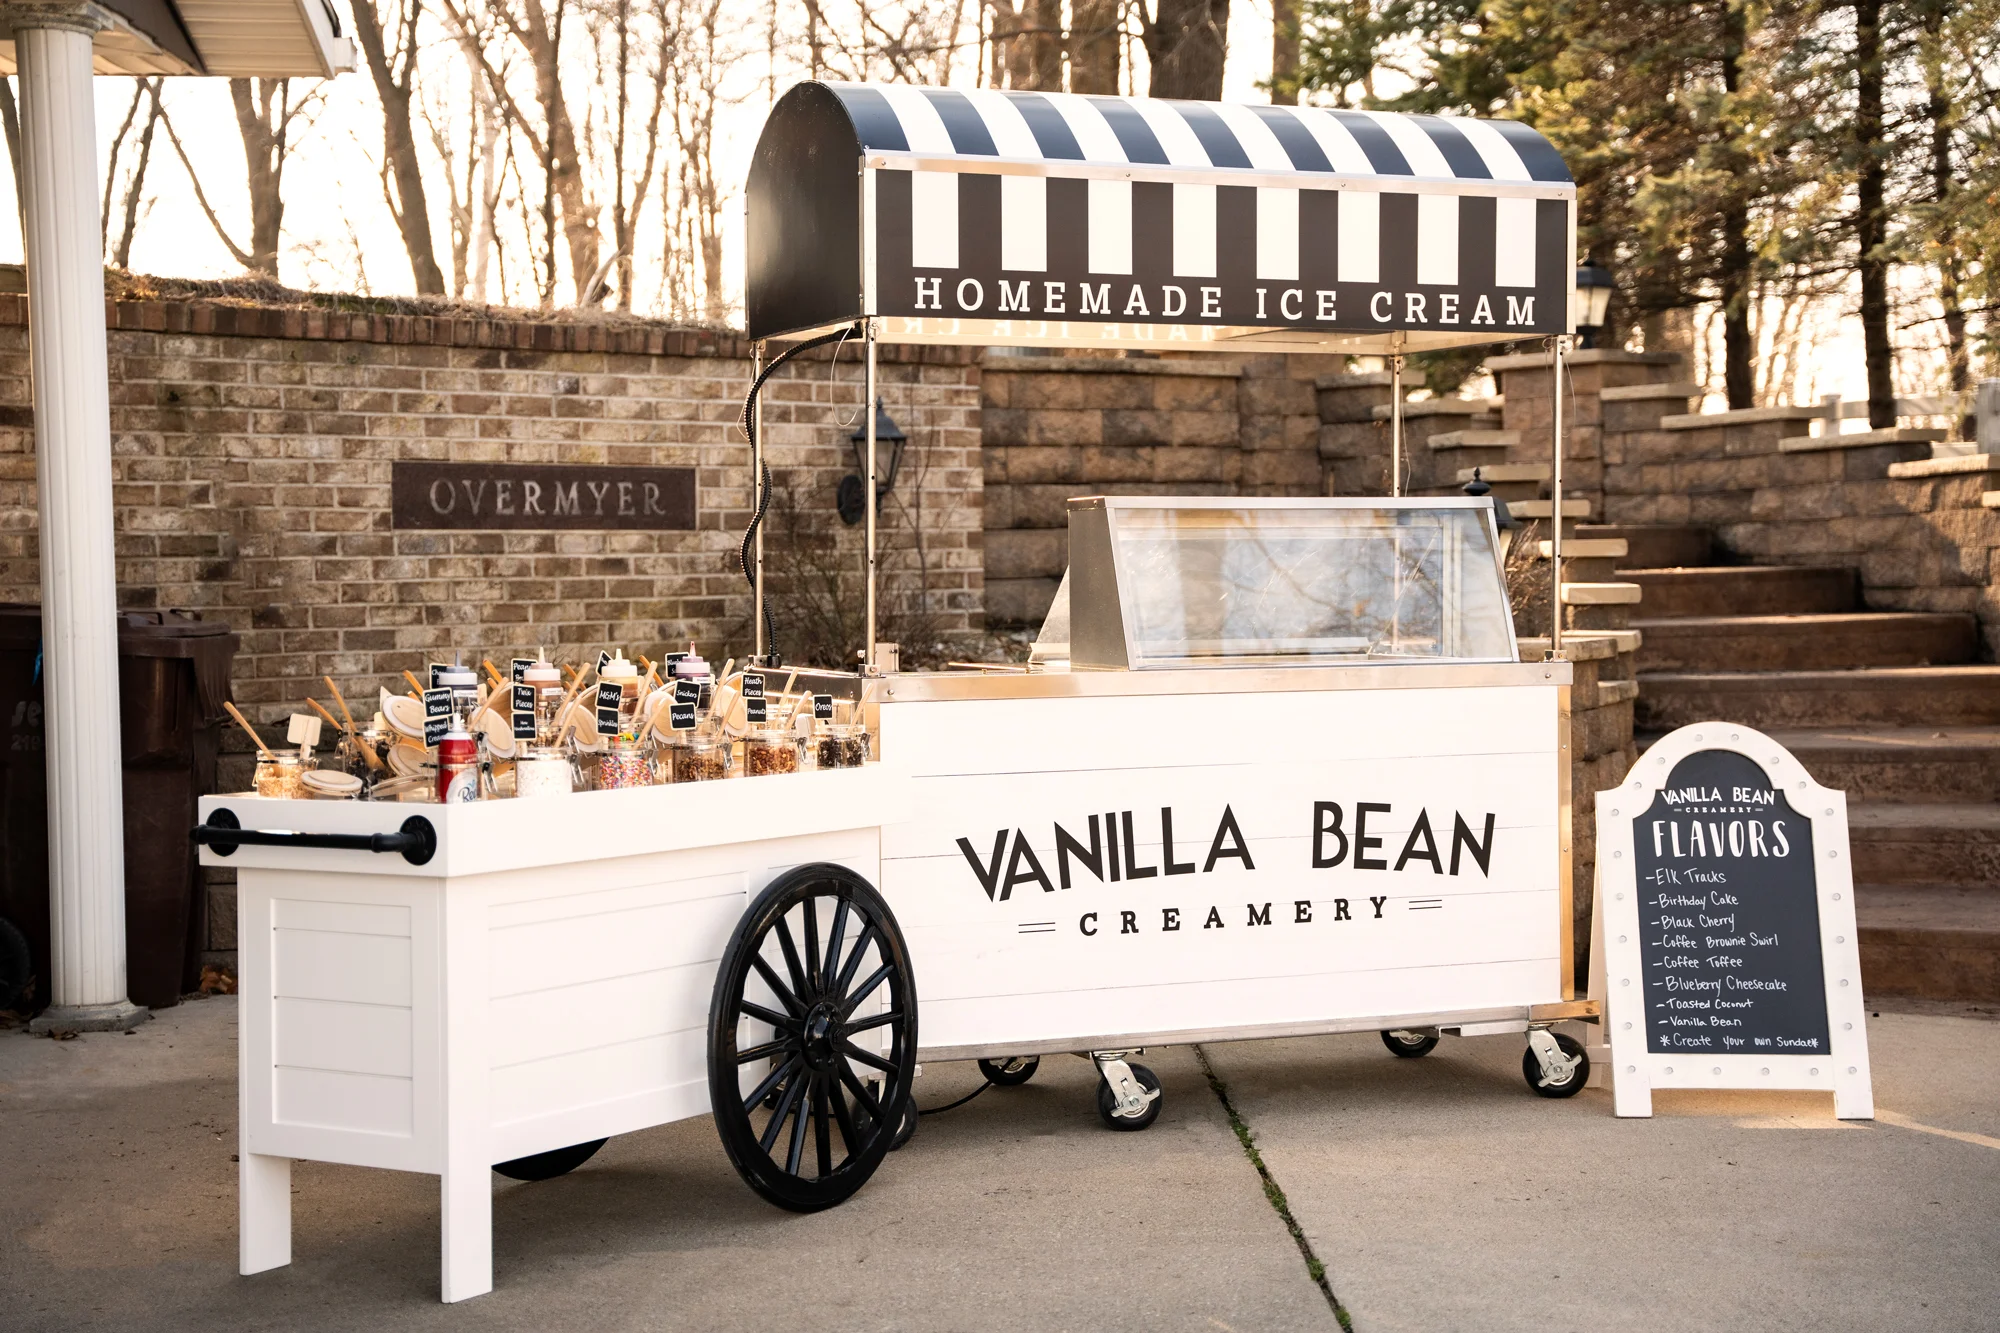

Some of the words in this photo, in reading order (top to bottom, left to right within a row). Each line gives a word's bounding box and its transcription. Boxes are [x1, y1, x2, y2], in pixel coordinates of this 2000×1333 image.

[914, 276, 1223, 319] HOMEMADE
[1255, 288, 1338, 321] ICE
[1370, 290, 1536, 326] CREAM
[428, 476, 667, 516] OVERMYER
[425, 690, 450, 703] Gummy
[672, 712, 694, 721] Pecans
[1660, 786, 1723, 806] VANILLA
[1732, 787, 1775, 806] BEAN
[1652, 820, 1790, 858] FLAVORS
[955, 802, 1255, 903] VANILLA
[1311, 800, 1496, 879] BEAN
[1683, 867, 1727, 884] Tracks
[1710, 890, 1739, 906] Cake
[1079, 896, 1387, 937] CREAMERY
[1698, 913, 1735, 933] Cherry
[1706, 936, 1746, 949] Brownie
[1749, 932, 1779, 947] Swirl
[1706, 956, 1743, 968] Toffee
[1725, 975, 1787, 992] Cheesecake
[1714, 998, 1754, 1009] Coconut
[1710, 1016, 1742, 1027] Bean
[1723, 1035, 1745, 1050] your
[1754, 1037, 1771, 1047] own
